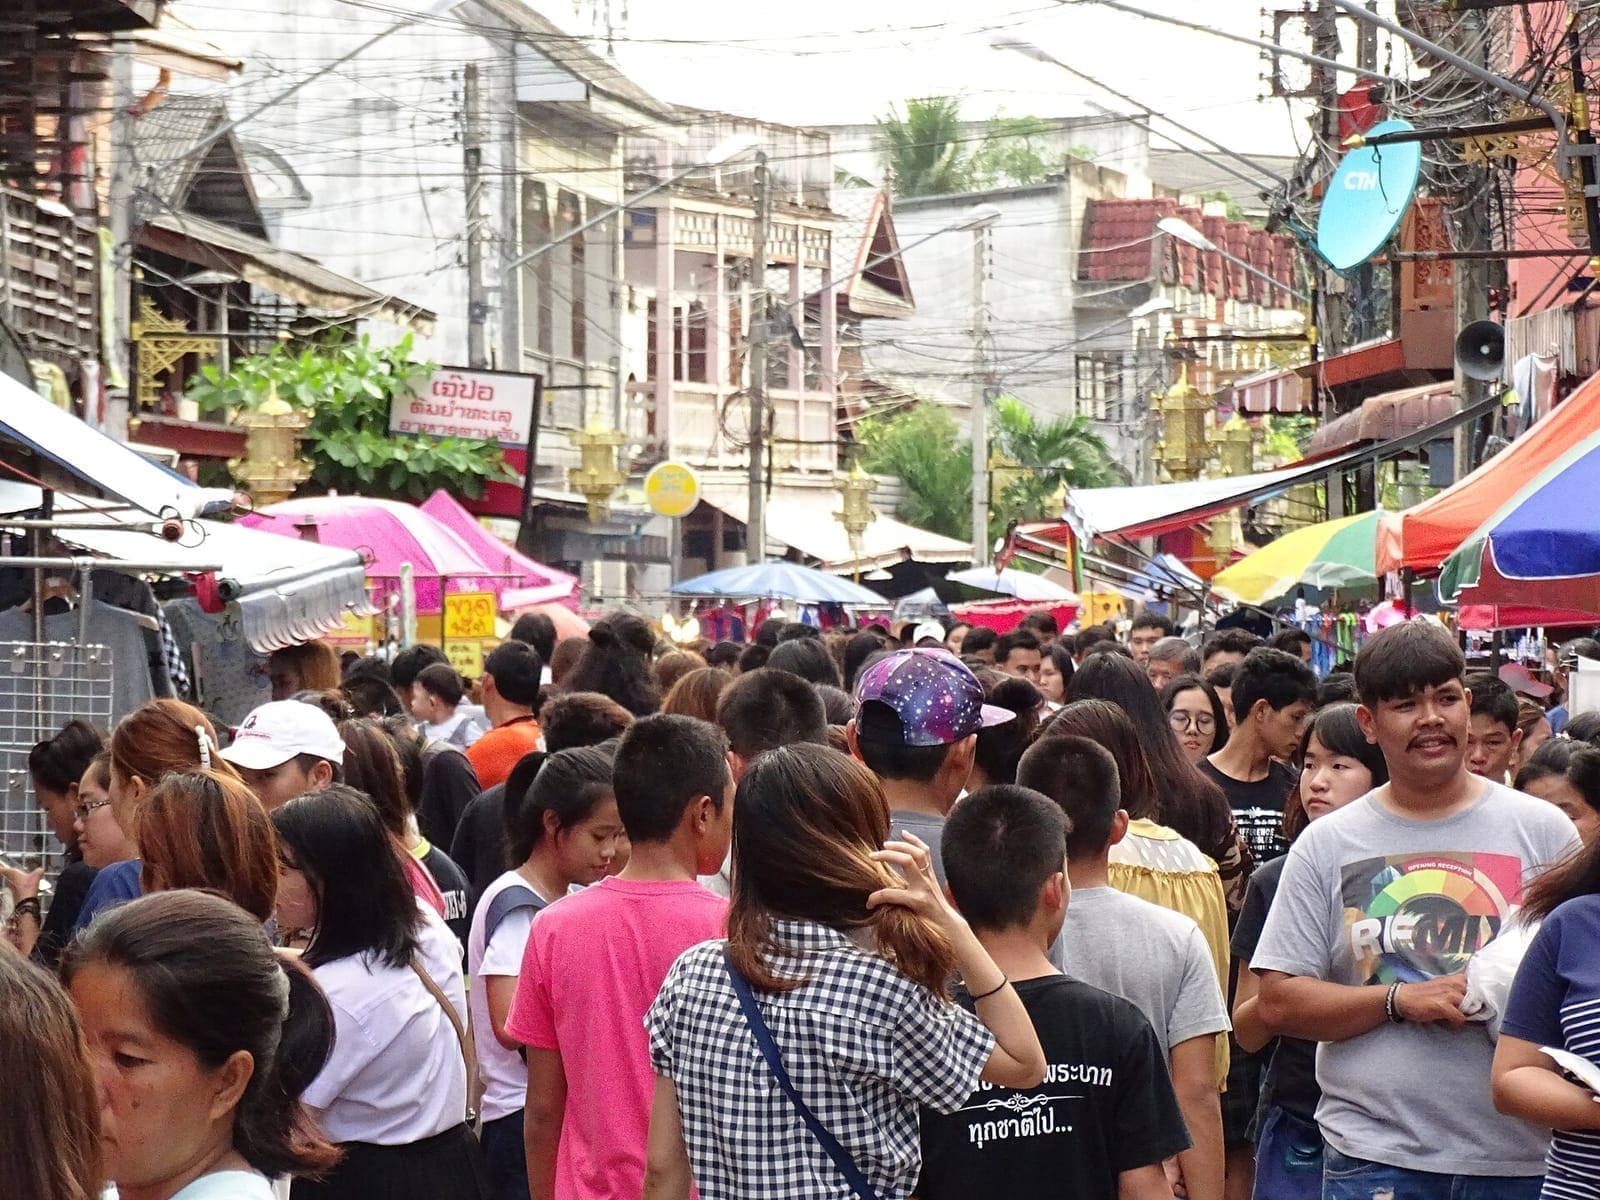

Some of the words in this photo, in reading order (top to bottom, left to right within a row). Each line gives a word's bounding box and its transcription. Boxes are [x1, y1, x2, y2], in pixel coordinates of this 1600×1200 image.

[1344, 171, 1376, 190] CTH
[1407, 861, 1437, 872] OPENING
[1437, 862, 1473, 877] RECEPTION
